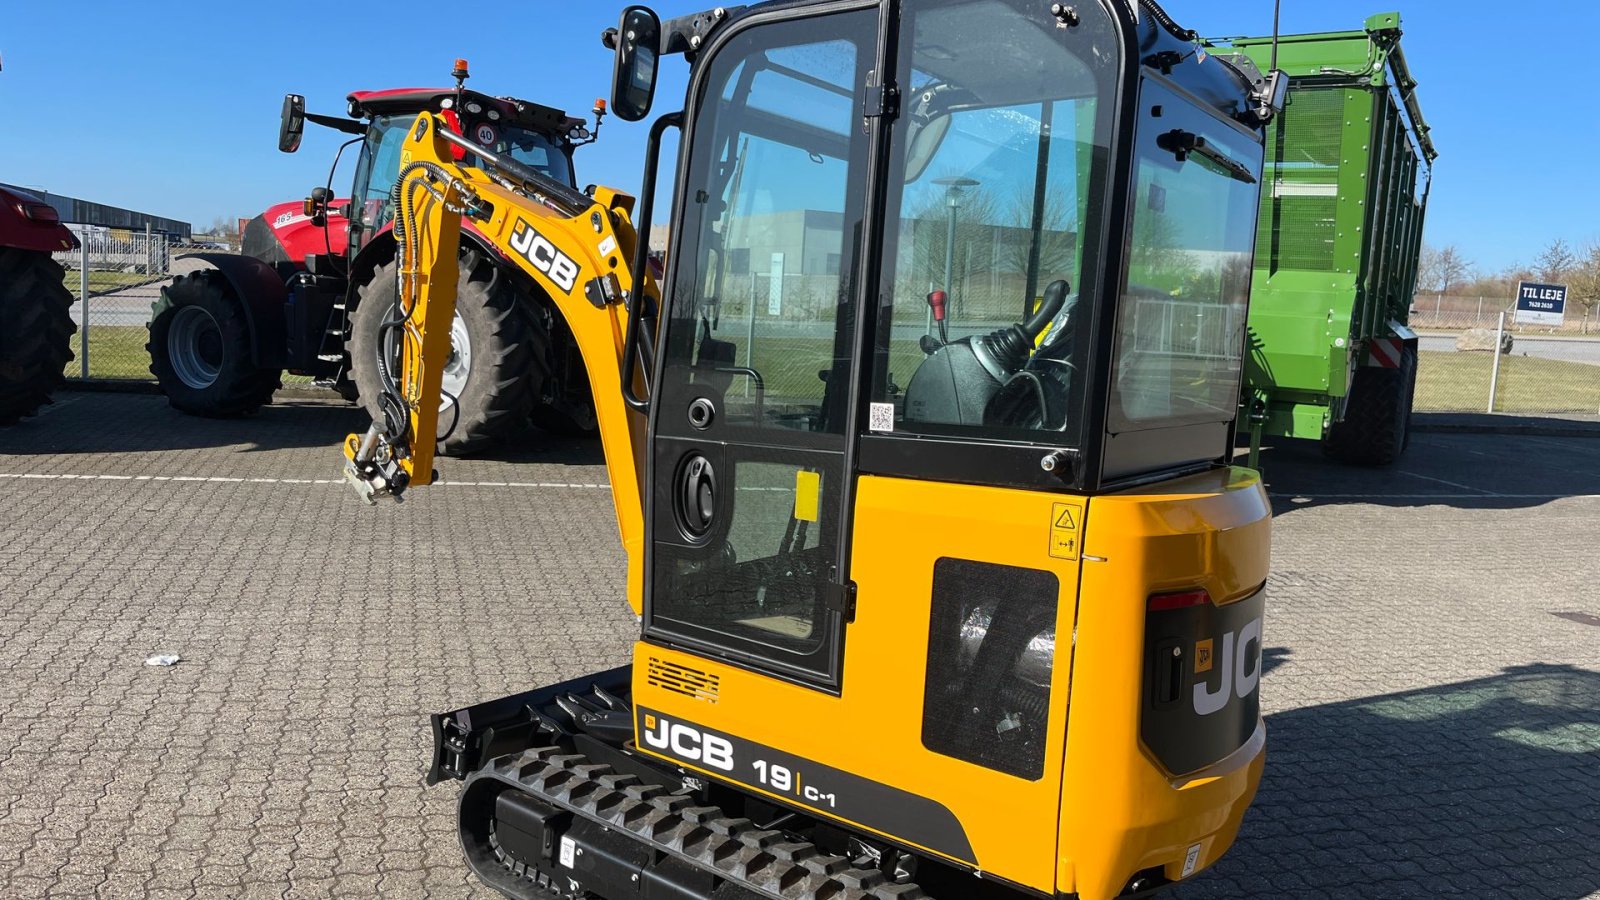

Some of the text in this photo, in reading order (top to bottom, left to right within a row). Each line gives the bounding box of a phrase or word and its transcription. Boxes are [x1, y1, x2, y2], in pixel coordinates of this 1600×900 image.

[480, 130, 492, 140] 40
[277, 213, 291, 224] 165
[510, 227, 578, 291] JCB
[1523, 287, 1563, 301] TIL LEJE
[1193, 616, 1261, 716] JC
[645, 718, 734, 771] JCB
[752, 760, 791, 791] 19
